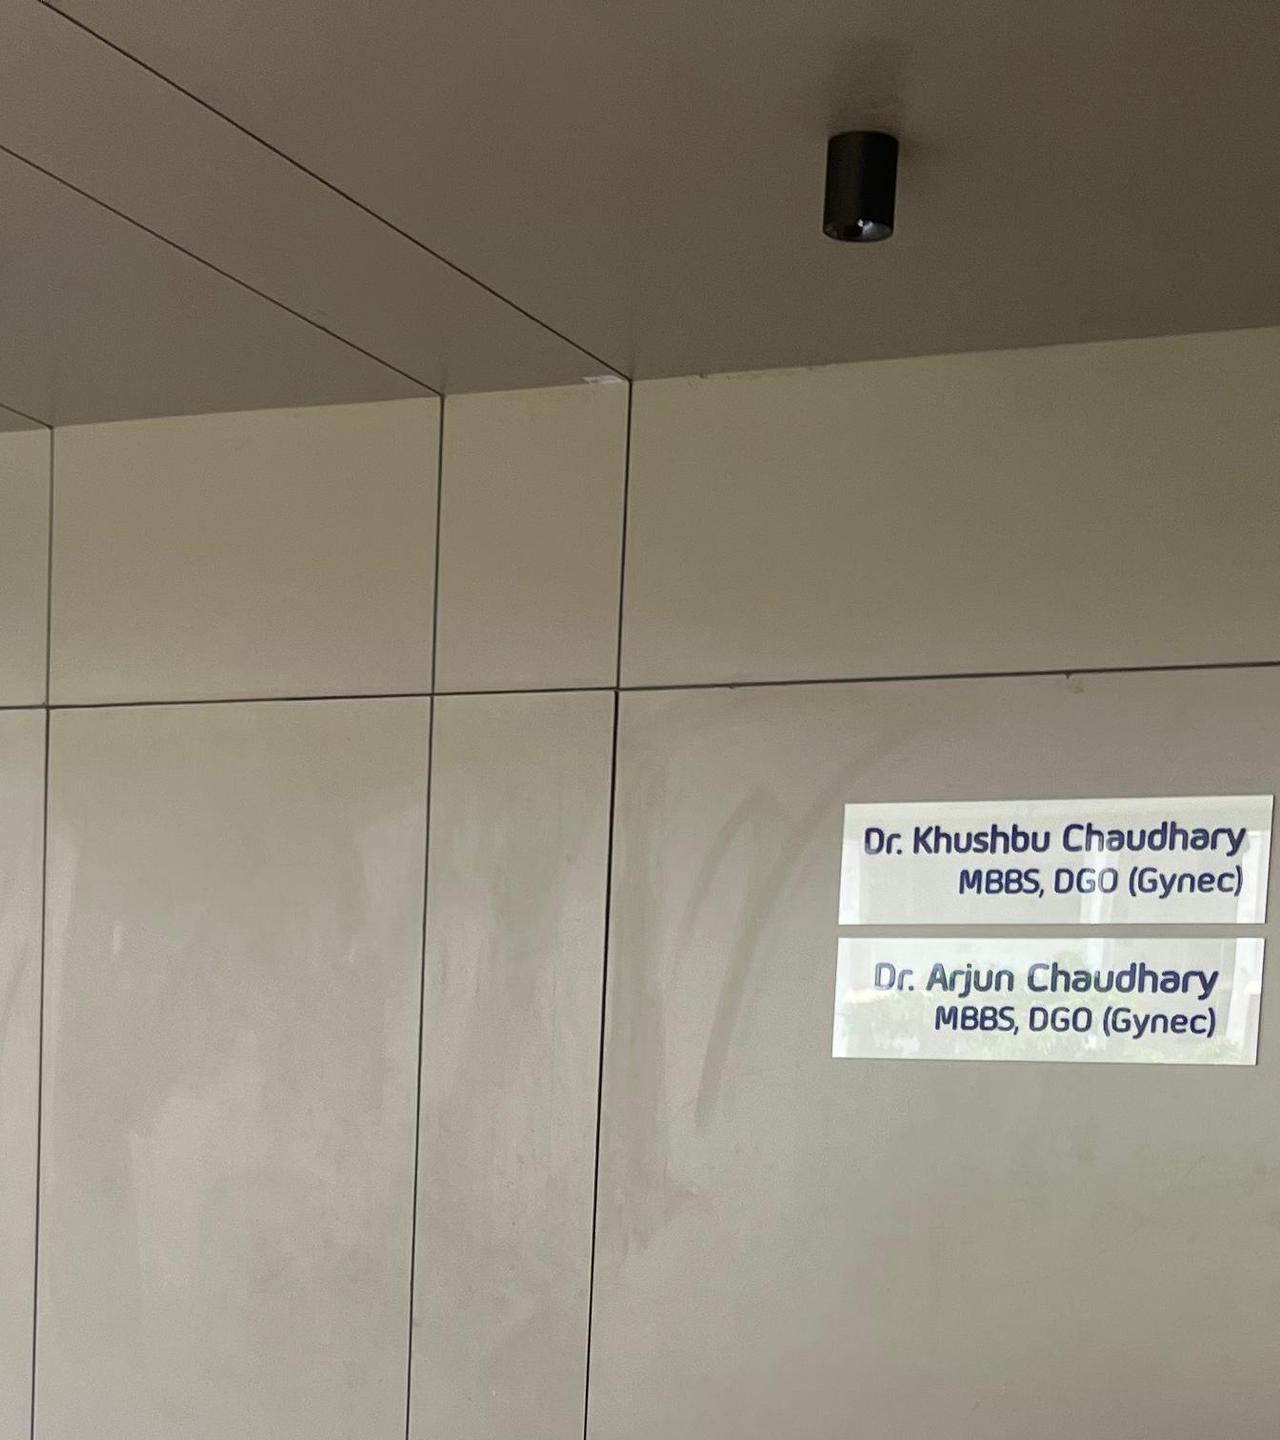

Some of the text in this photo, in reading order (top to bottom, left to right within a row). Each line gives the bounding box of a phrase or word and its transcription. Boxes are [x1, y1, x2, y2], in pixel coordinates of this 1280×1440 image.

[864, 821, 1246, 856] Dr. Khushbu Chaudhary
[959, 865, 1243, 899] MBBS, DGO (Gynec)
[874, 962, 1219, 1001] Dr. Arjun Chaudhary
[935, 1006, 1216, 1039] MBBS, DGO (Gynec)
